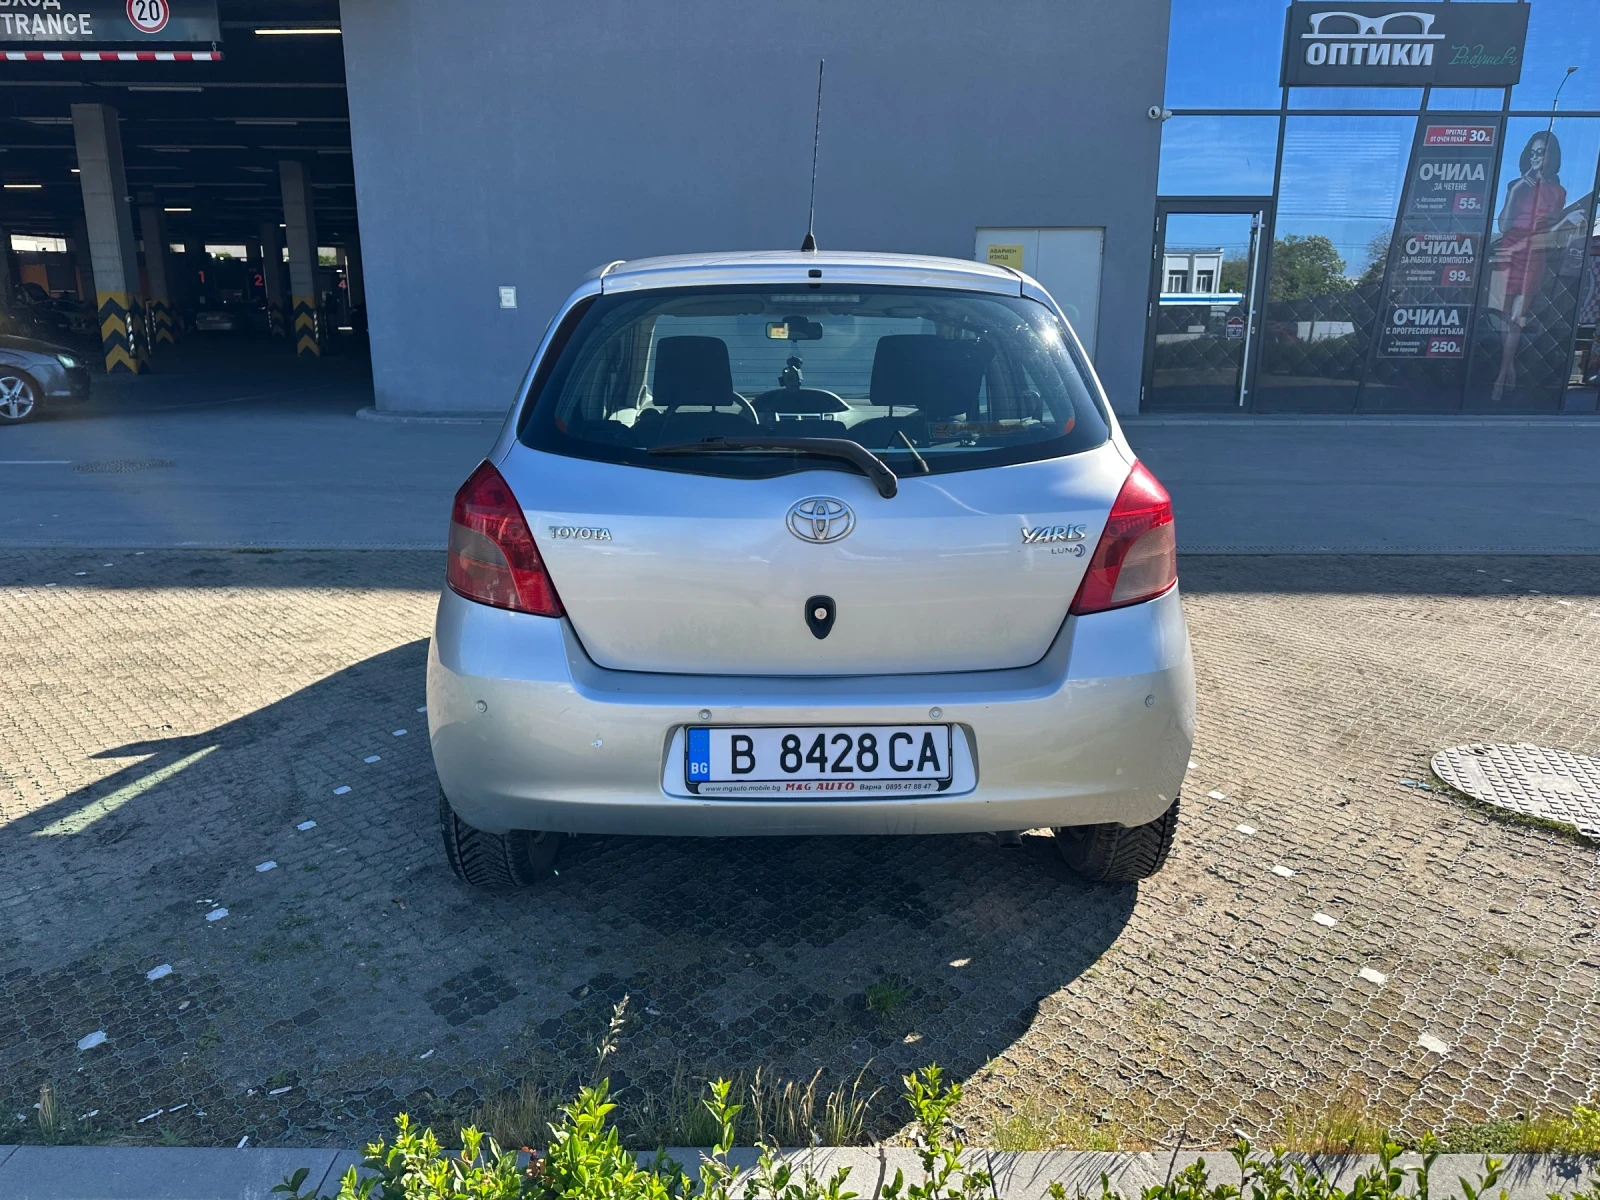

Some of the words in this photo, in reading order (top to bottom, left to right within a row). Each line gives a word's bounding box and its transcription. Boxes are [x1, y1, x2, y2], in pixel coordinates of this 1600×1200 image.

[137, 0, 160, 21] 20
[0, 13, 93, 35] TRANCE
[1306, 42, 1434, 66] ОПТИКИ
[1420, 163, 1485, 180] ОЧИЛА
[1434, 183, 1442, 191] ЗА
[1443, 183, 1467, 191] ЧЕТЕНЕ
[1405, 238, 1473, 255] ОЧИЛА
[1401, 256, 1409, 264] ЗА
[1410, 256, 1431, 264] РАБОТА
[254, 274, 263, 286] 2
[338, 279, 347, 289] 4
[1393, 308, 1460, 326] ОЧИЛА
[1385, 327, 1391, 335] С
[1392, 327, 1439, 335] ПРОГРЕСИВНИ
[1440, 327, 1464, 335] СТЪКЛА
[548, 526, 612, 541] TOYOTA
[1051, 547, 1080, 555] LUNA
[731, 734, 756, 774] B
[779, 733, 879, 773] 8428
[888, 731, 941, 772] CA
[691, 762, 708, 774] BG
[705, 784, 781, 793] www.mgauto.mobile.bg
[785, 782, 811, 791] M&G
[815, 781, 855, 791] AUTO
[859, 784, 882, 792] Варна
[885, 783, 902, 791] 0895
[923, 782, 932, 790] 47
